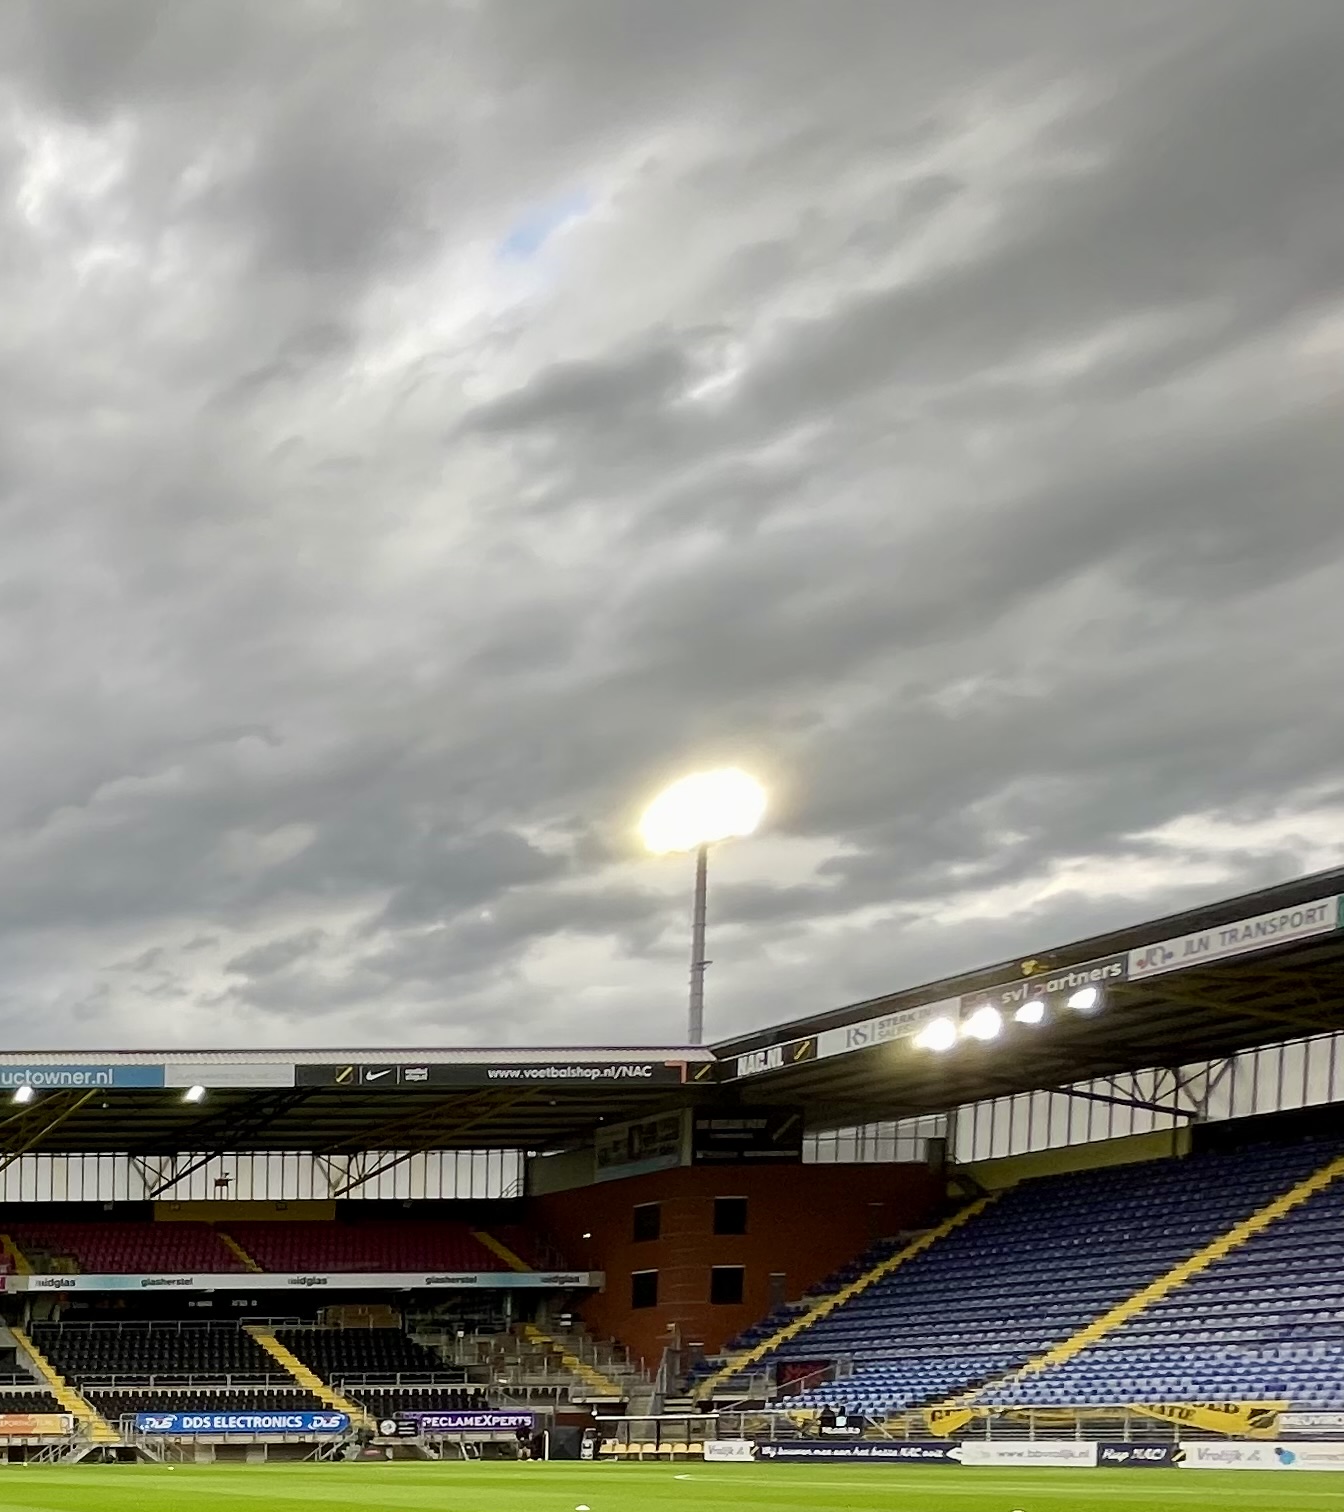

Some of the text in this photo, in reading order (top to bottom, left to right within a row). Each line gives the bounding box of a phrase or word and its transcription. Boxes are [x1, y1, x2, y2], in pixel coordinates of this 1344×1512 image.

[1218, 904, 1328, 947] TRANSPORT
[488, 1065, 652, 1081] www.voetbalshop.nl/NAC
[736, 1046, 784, 1077] NAC.NL
[182, 1415, 303, 1429] DDS ELECTRONICS
